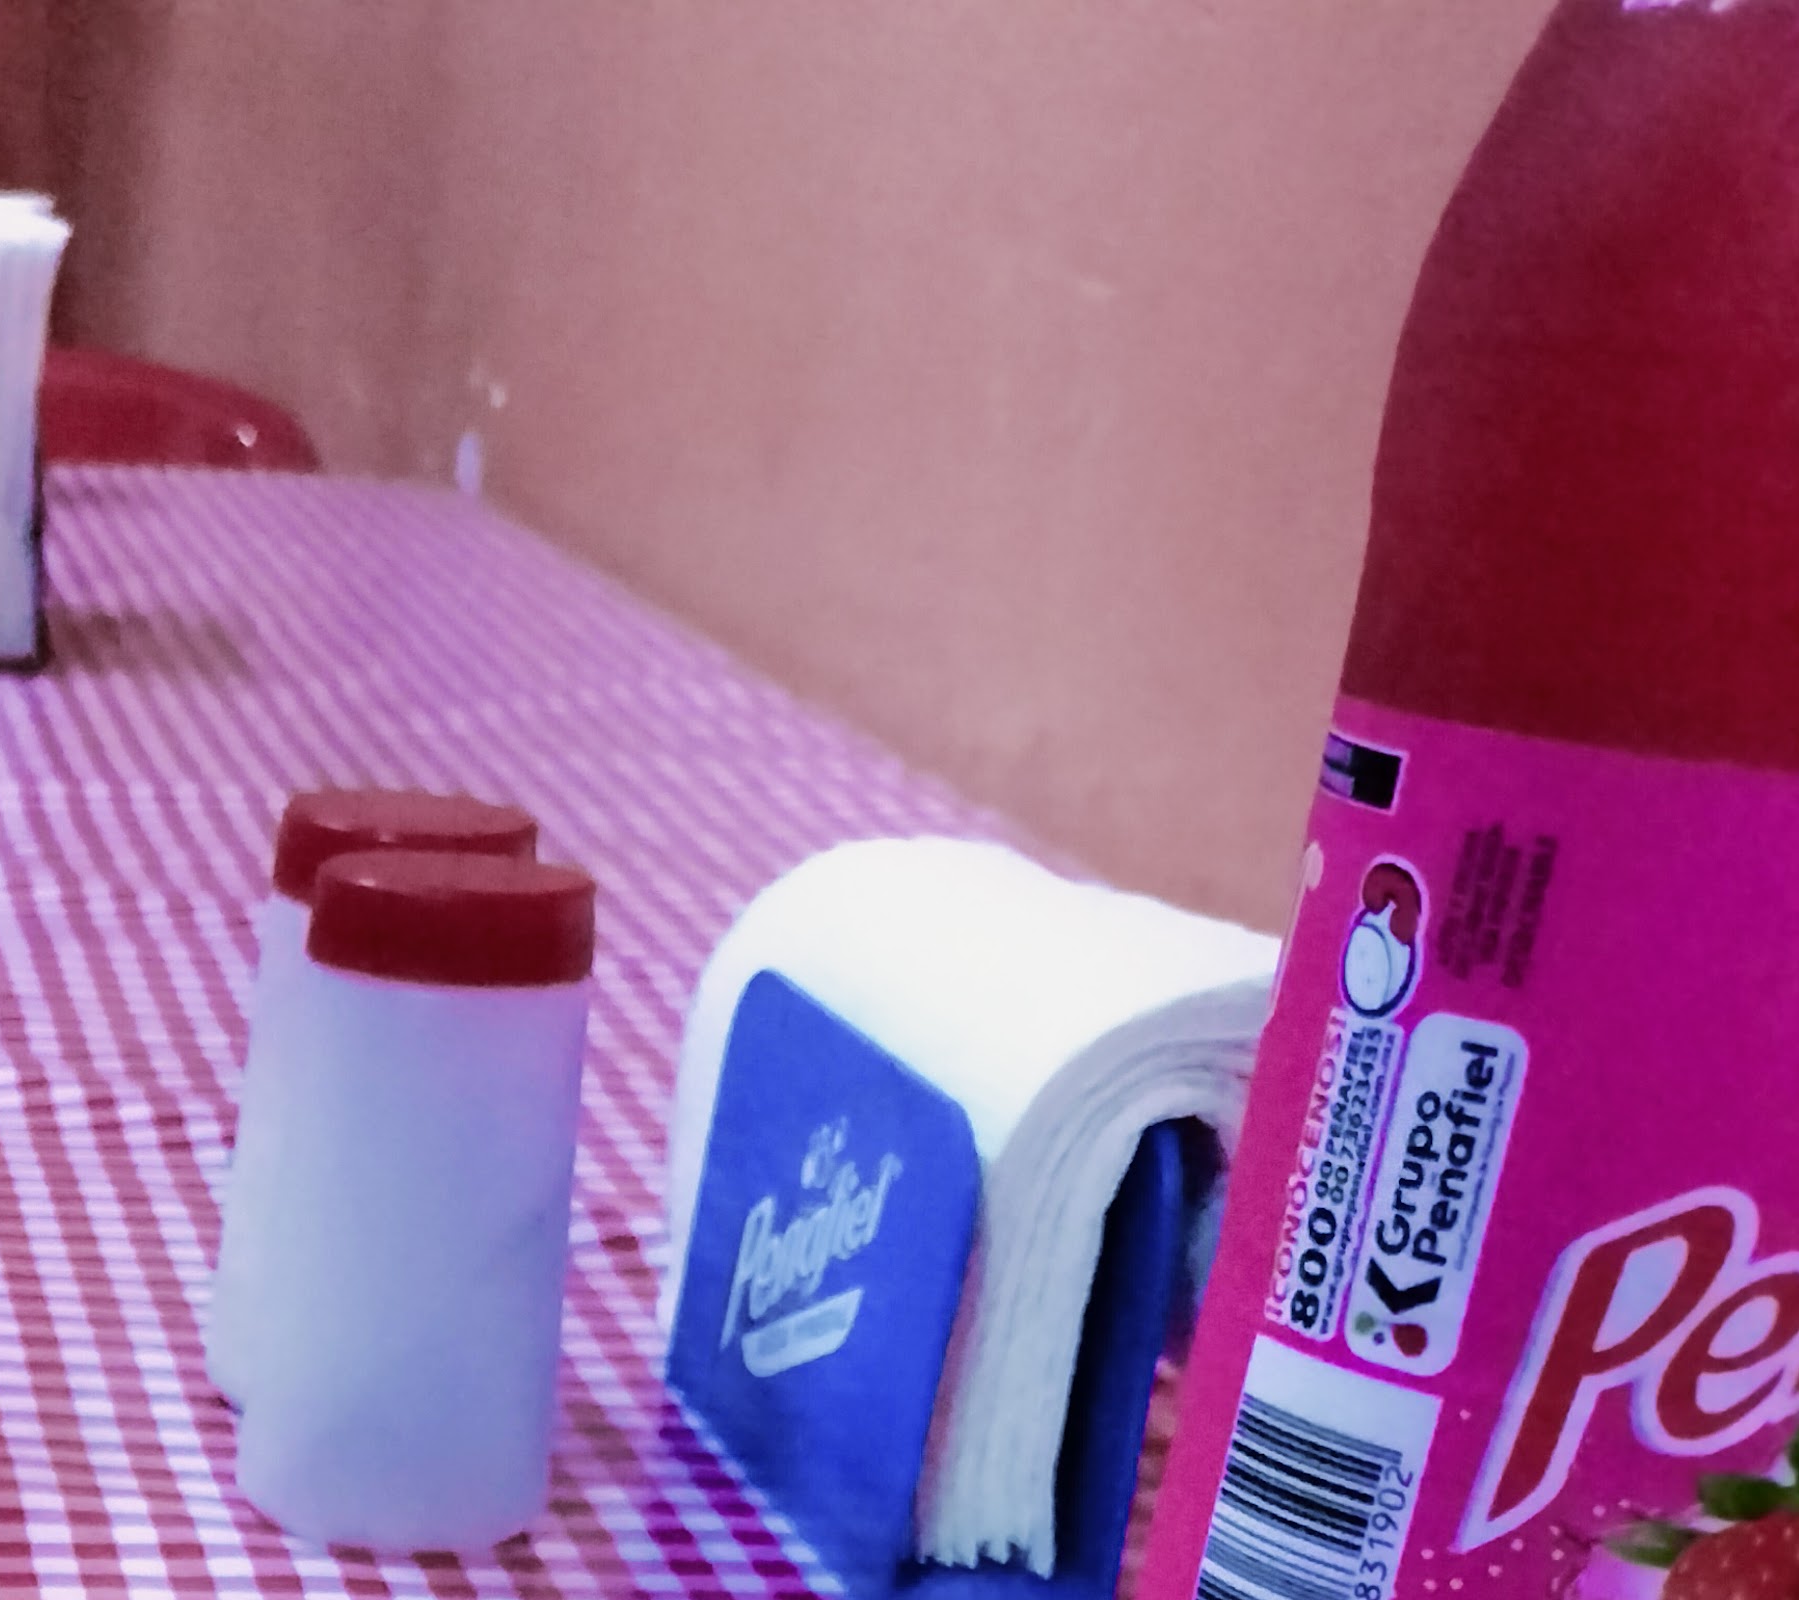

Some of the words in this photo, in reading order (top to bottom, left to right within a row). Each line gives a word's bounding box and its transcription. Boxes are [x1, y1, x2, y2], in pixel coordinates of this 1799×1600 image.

[1290, 1206, 1337, 1329] 800
[1314, 1159, 1334, 1199] 00
[1328, 1165, 1350, 1205] 00
[1372, 1088, 1443, 1257] Grupo
[1462, 1194, 1799, 1542] Pe
